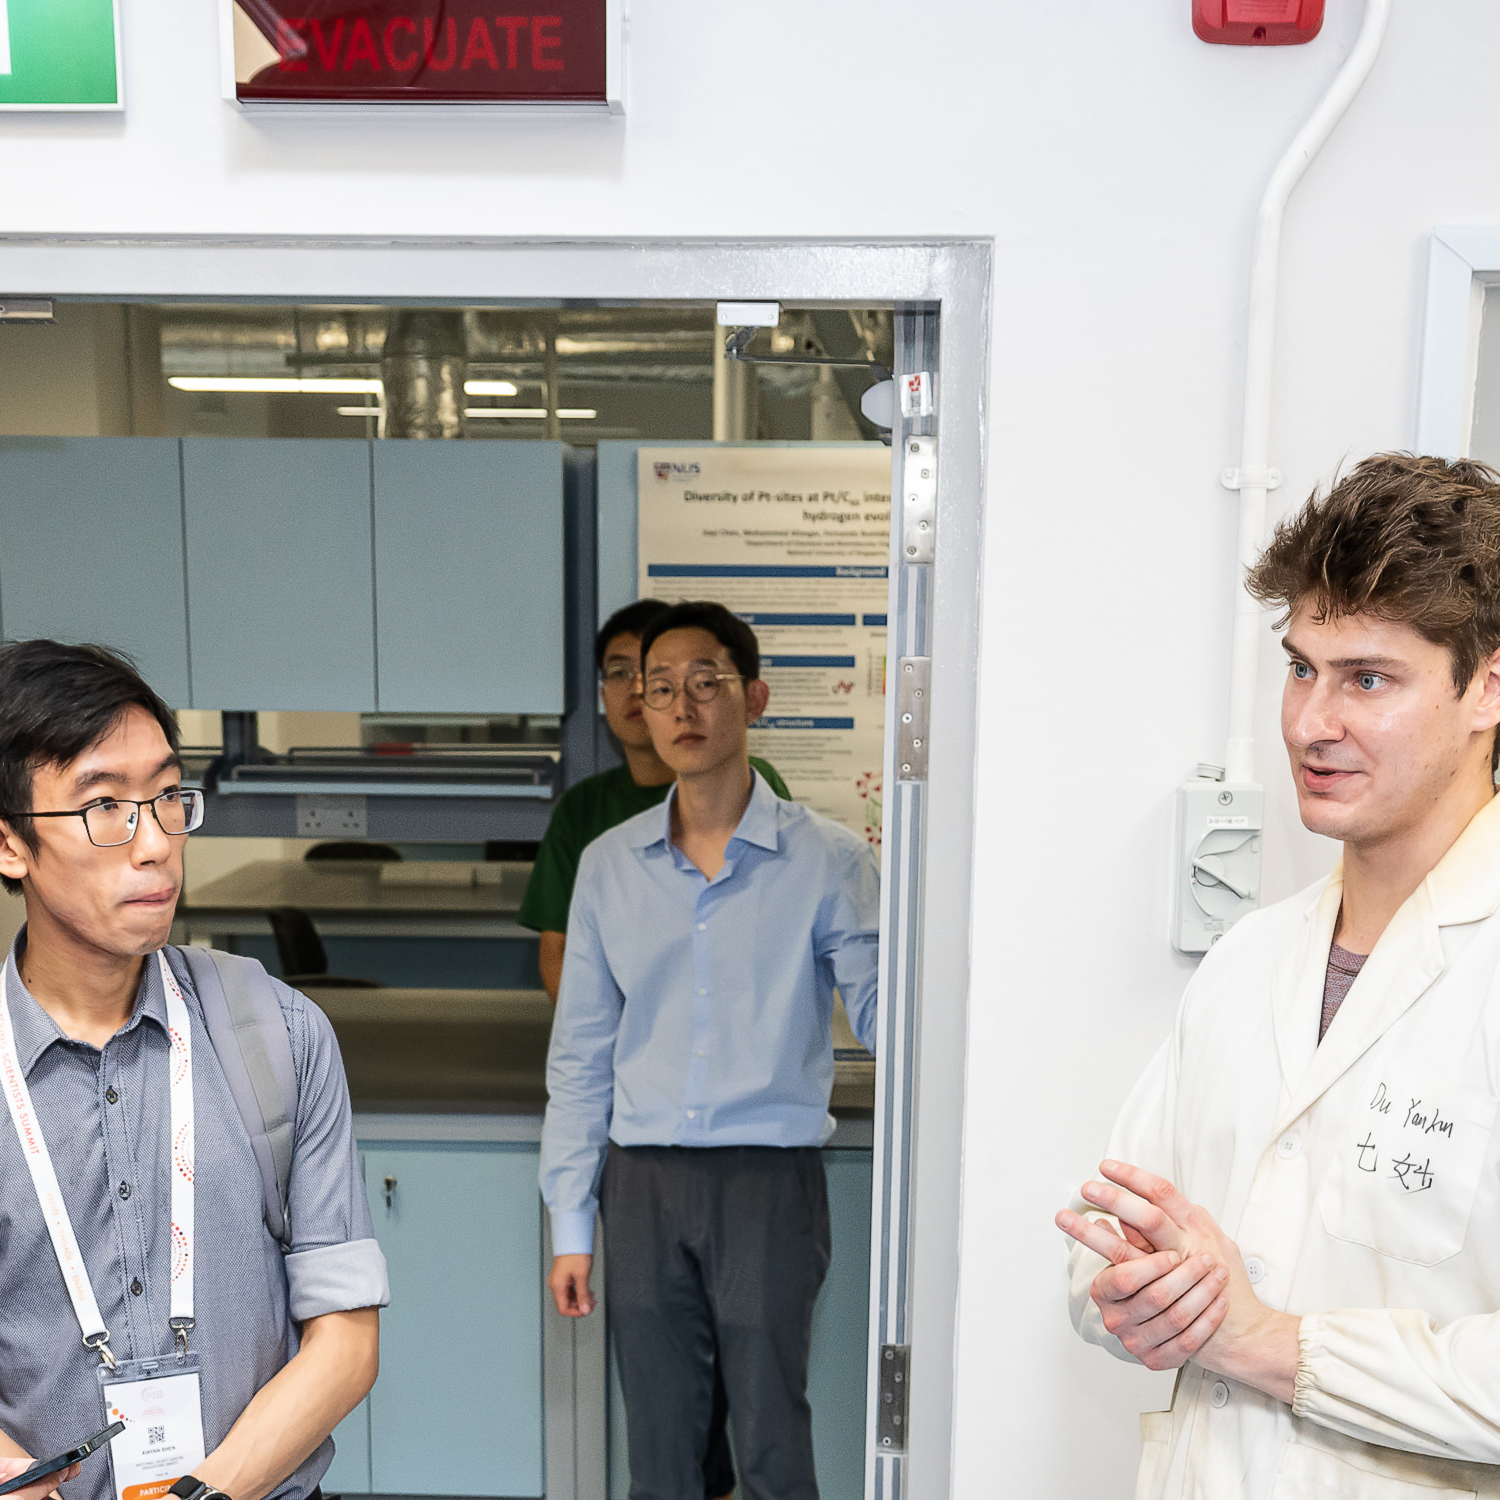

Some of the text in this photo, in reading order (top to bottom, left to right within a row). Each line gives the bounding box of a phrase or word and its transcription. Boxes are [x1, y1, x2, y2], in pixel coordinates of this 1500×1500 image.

[276, 15, 565, 72] EVACUATE
[683, 490, 738, 504] Diversity
[741, 489, 756, 502] of
[808, 491, 820, 502] at
[802, 509, 861, 524] hydrogen
[1370, 1082, 1391, 1114] Du
[19, 1112, 40, 1156] SUMMIT
